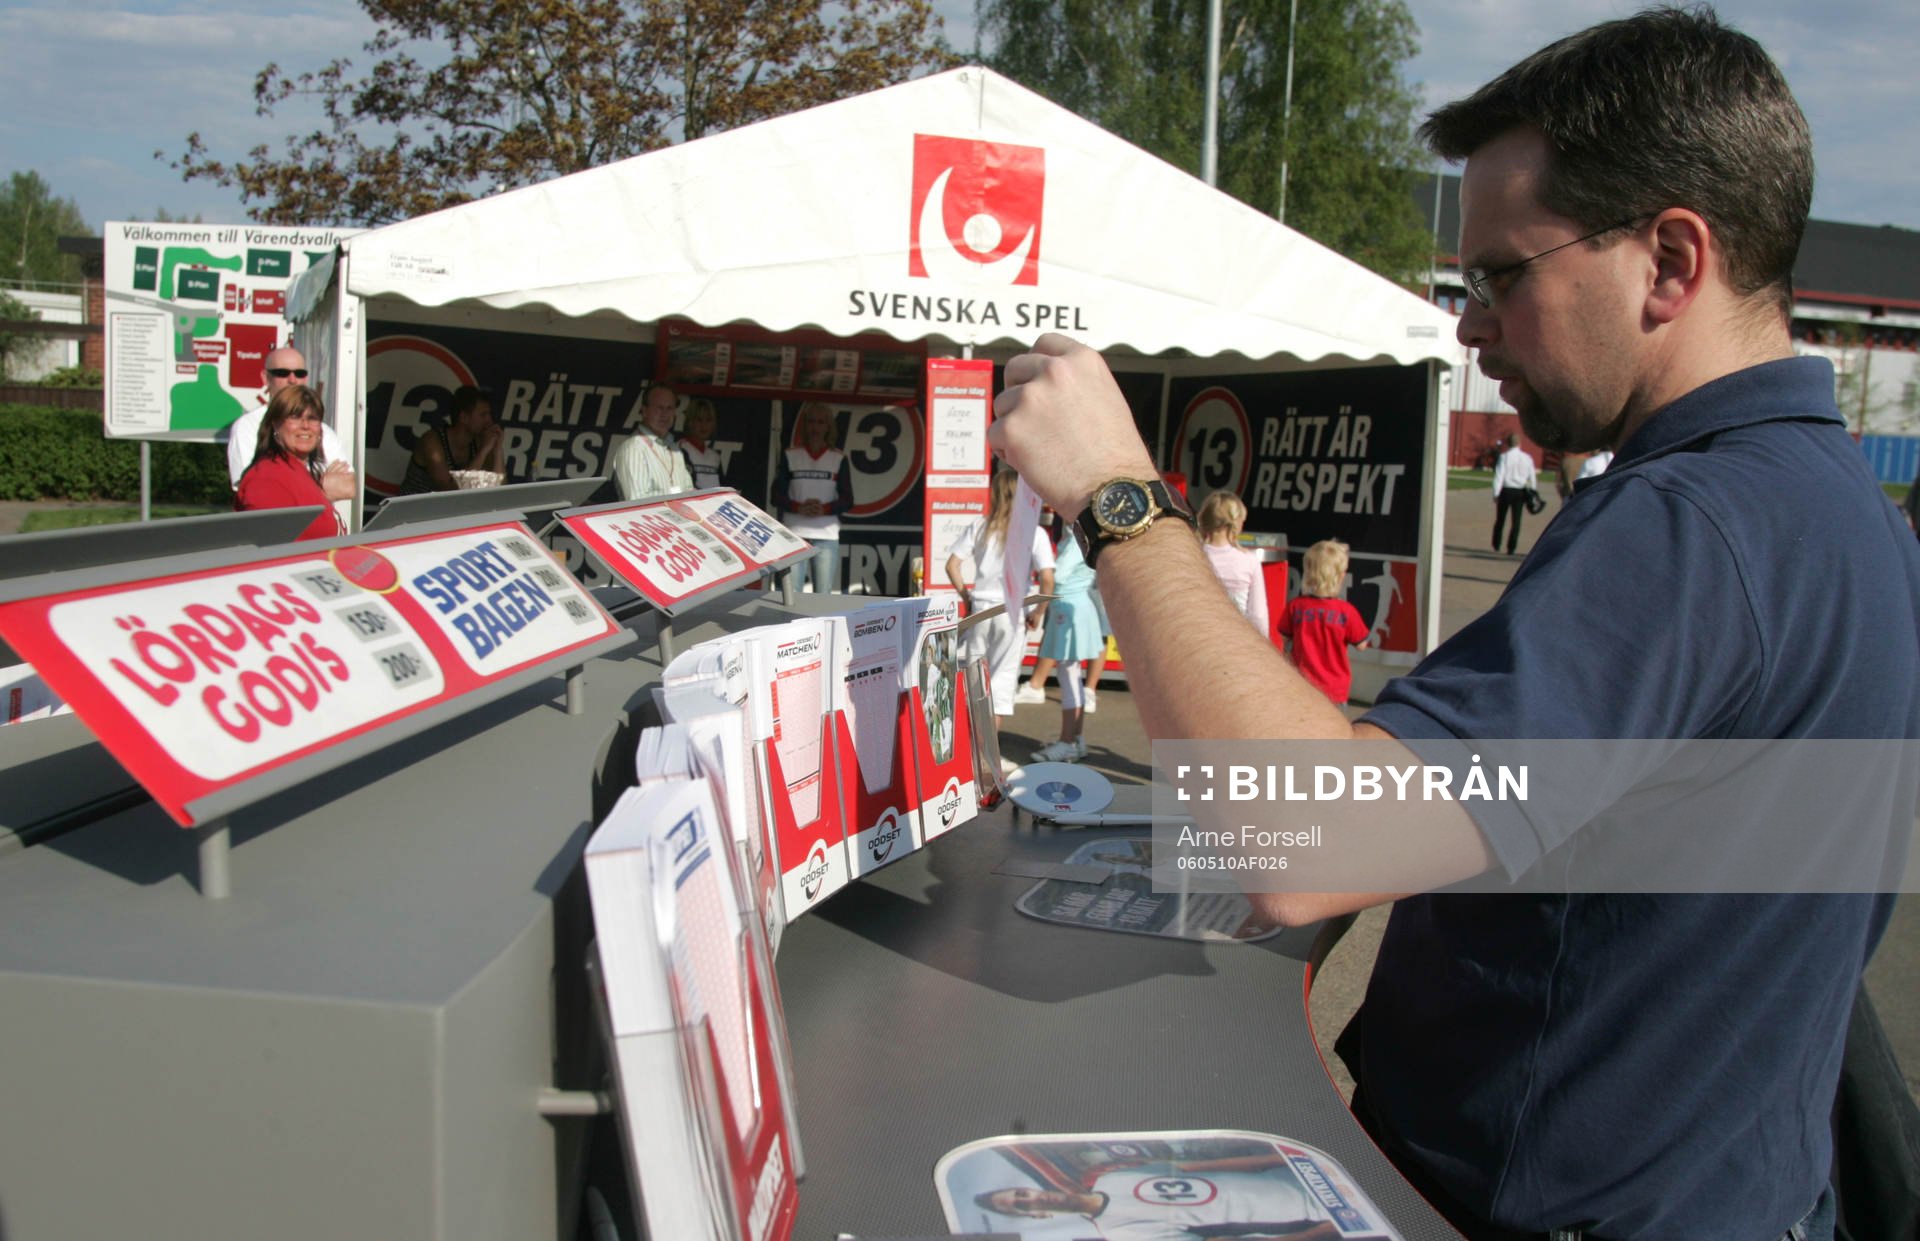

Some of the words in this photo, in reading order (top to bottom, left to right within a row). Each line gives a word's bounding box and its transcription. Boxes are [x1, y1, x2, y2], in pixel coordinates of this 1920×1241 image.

[123, 226, 211, 242] Välkommen
[217, 229, 239, 243] till
[244, 229, 342, 246] Värendsvalle
[848, 290, 1002, 326] SVENSKA
[1015, 303, 1089, 331] SPEL
[501, 373, 622, 427] RÄTT
[1259, 407, 1330, 457] RÄTT
[1328, 406, 1372, 458] ÄR
[1188, 428, 1238, 490] 13
[1251, 463, 1406, 516] RESPEKT
[609, 514, 683, 564] LÖRDAGS
[655, 536, 707, 583] GODIS
[412, 541, 518, 615] SPORT
[451, 573, 555, 660] BAGEN
[854, 623, 884, 639] BOMBEN
[917, 608, 945, 619] PROGRAM
[109, 582, 322, 707] LÖRDAGS
[776, 643, 814, 659] MATCHEN
[201, 631, 350, 744] GODIS
[937, 797, 962, 816] ODDSET
[868, 828, 902, 851] ODDSET
[800, 863, 830, 888] ODDSET
[1152, 1180, 1198, 1201] 13
[1294, 1161, 1345, 1208] STRYKTIPSET
